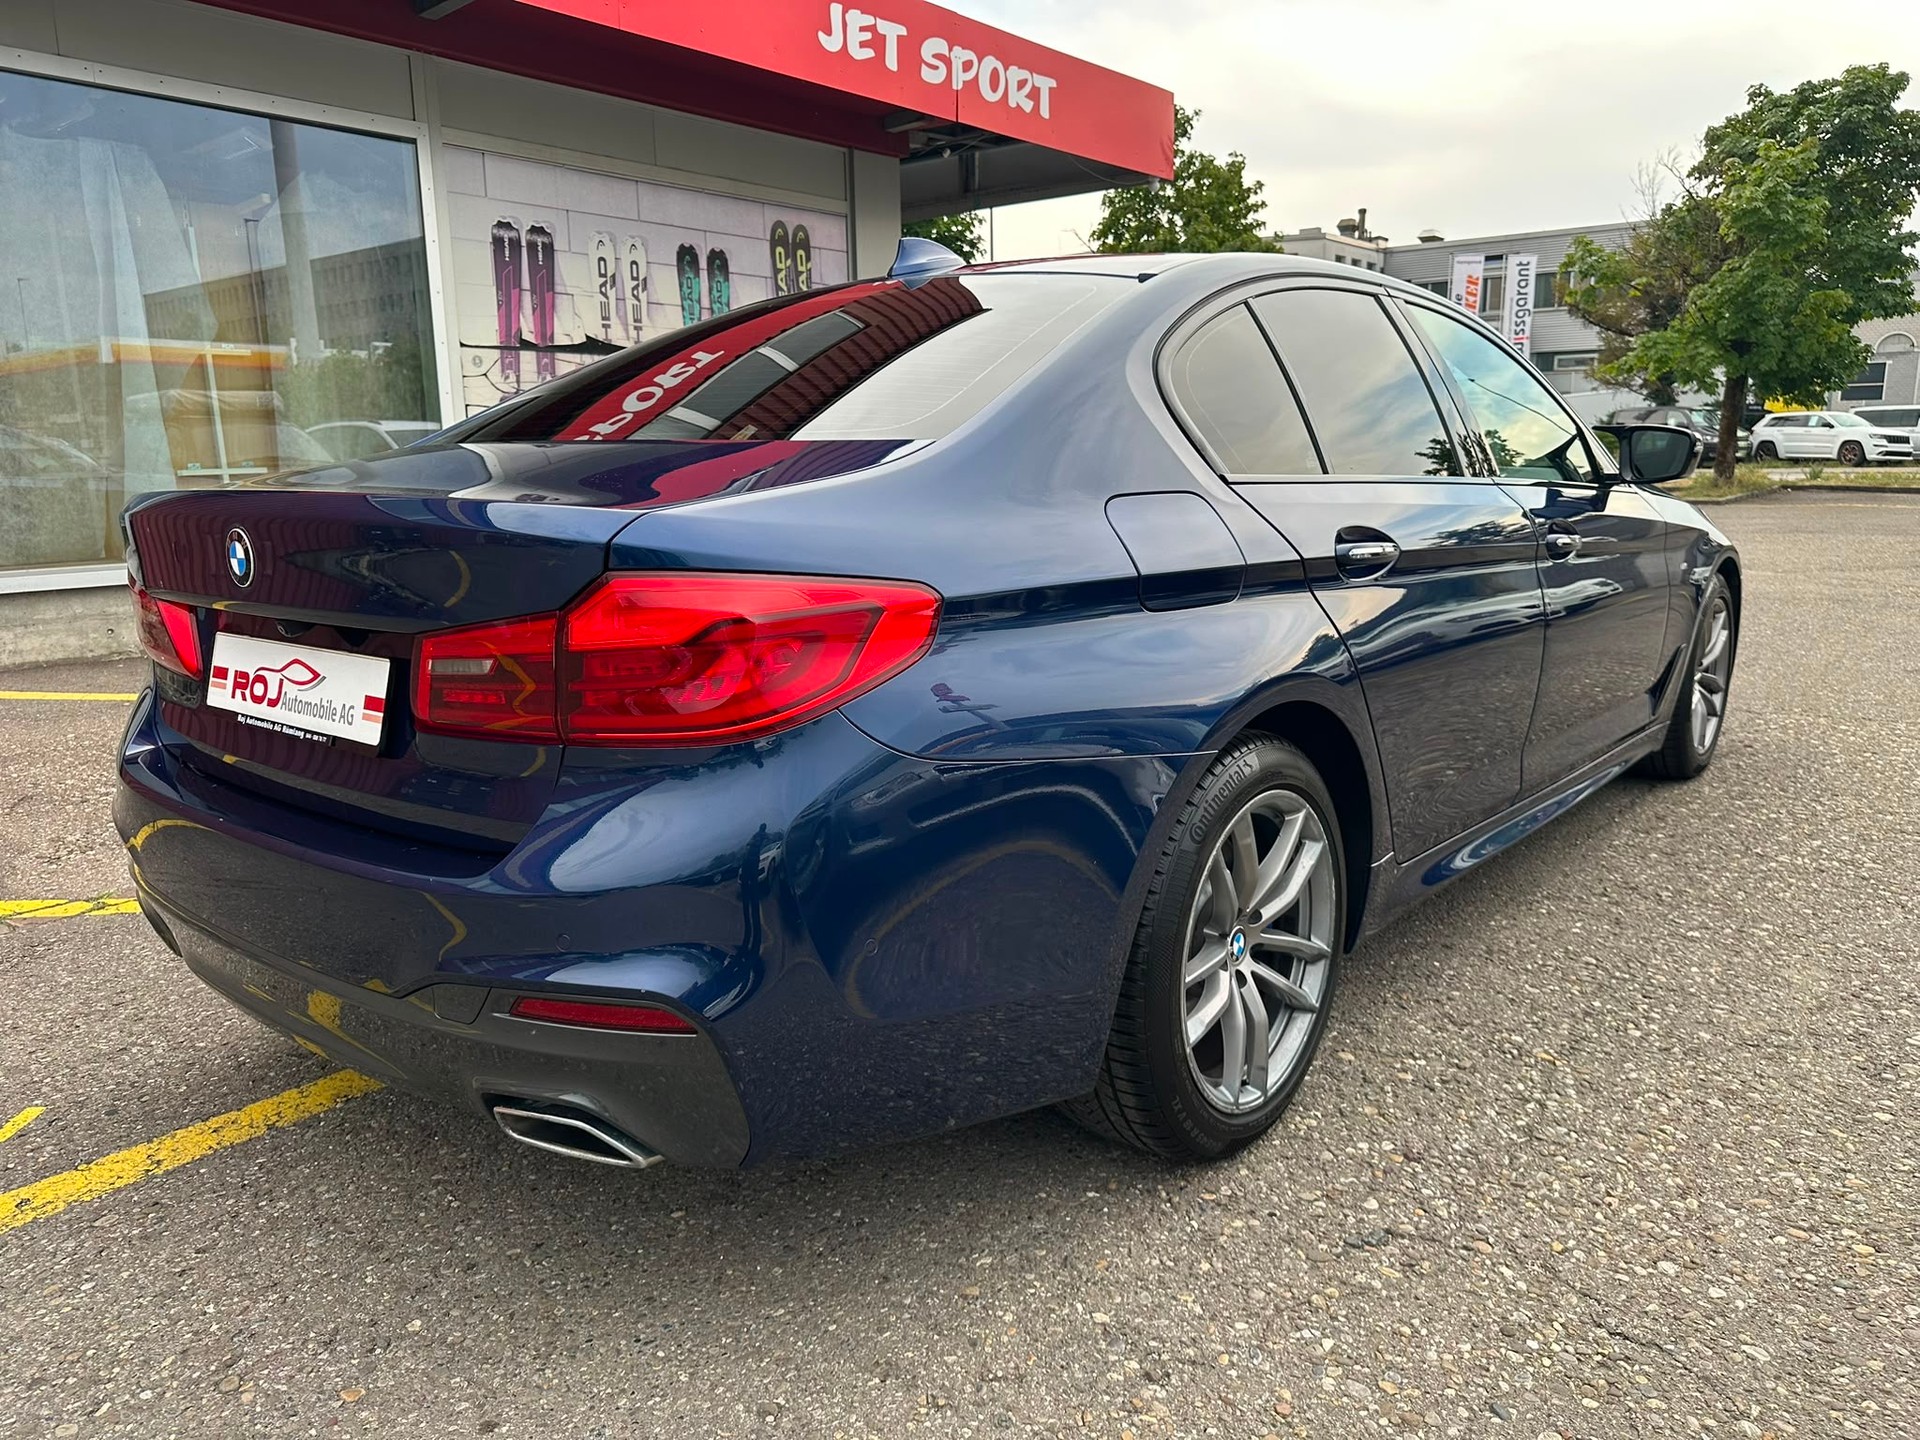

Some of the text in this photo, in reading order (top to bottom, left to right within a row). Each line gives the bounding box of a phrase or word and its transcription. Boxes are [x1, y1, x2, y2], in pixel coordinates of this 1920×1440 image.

[817, 2, 1057, 120] JET SPORT
[597, 256, 613, 344] HEAD
[629, 259, 644, 345] HEAD
[1463, 274, 1480, 315] KER
[231, 669, 285, 708] ROJ
[280, 691, 355, 726] Automobile AG
[246, 716, 274, 731] Automobile
[273, 723, 283, 732] AG
[1189, 764, 1247, 845] Continental
